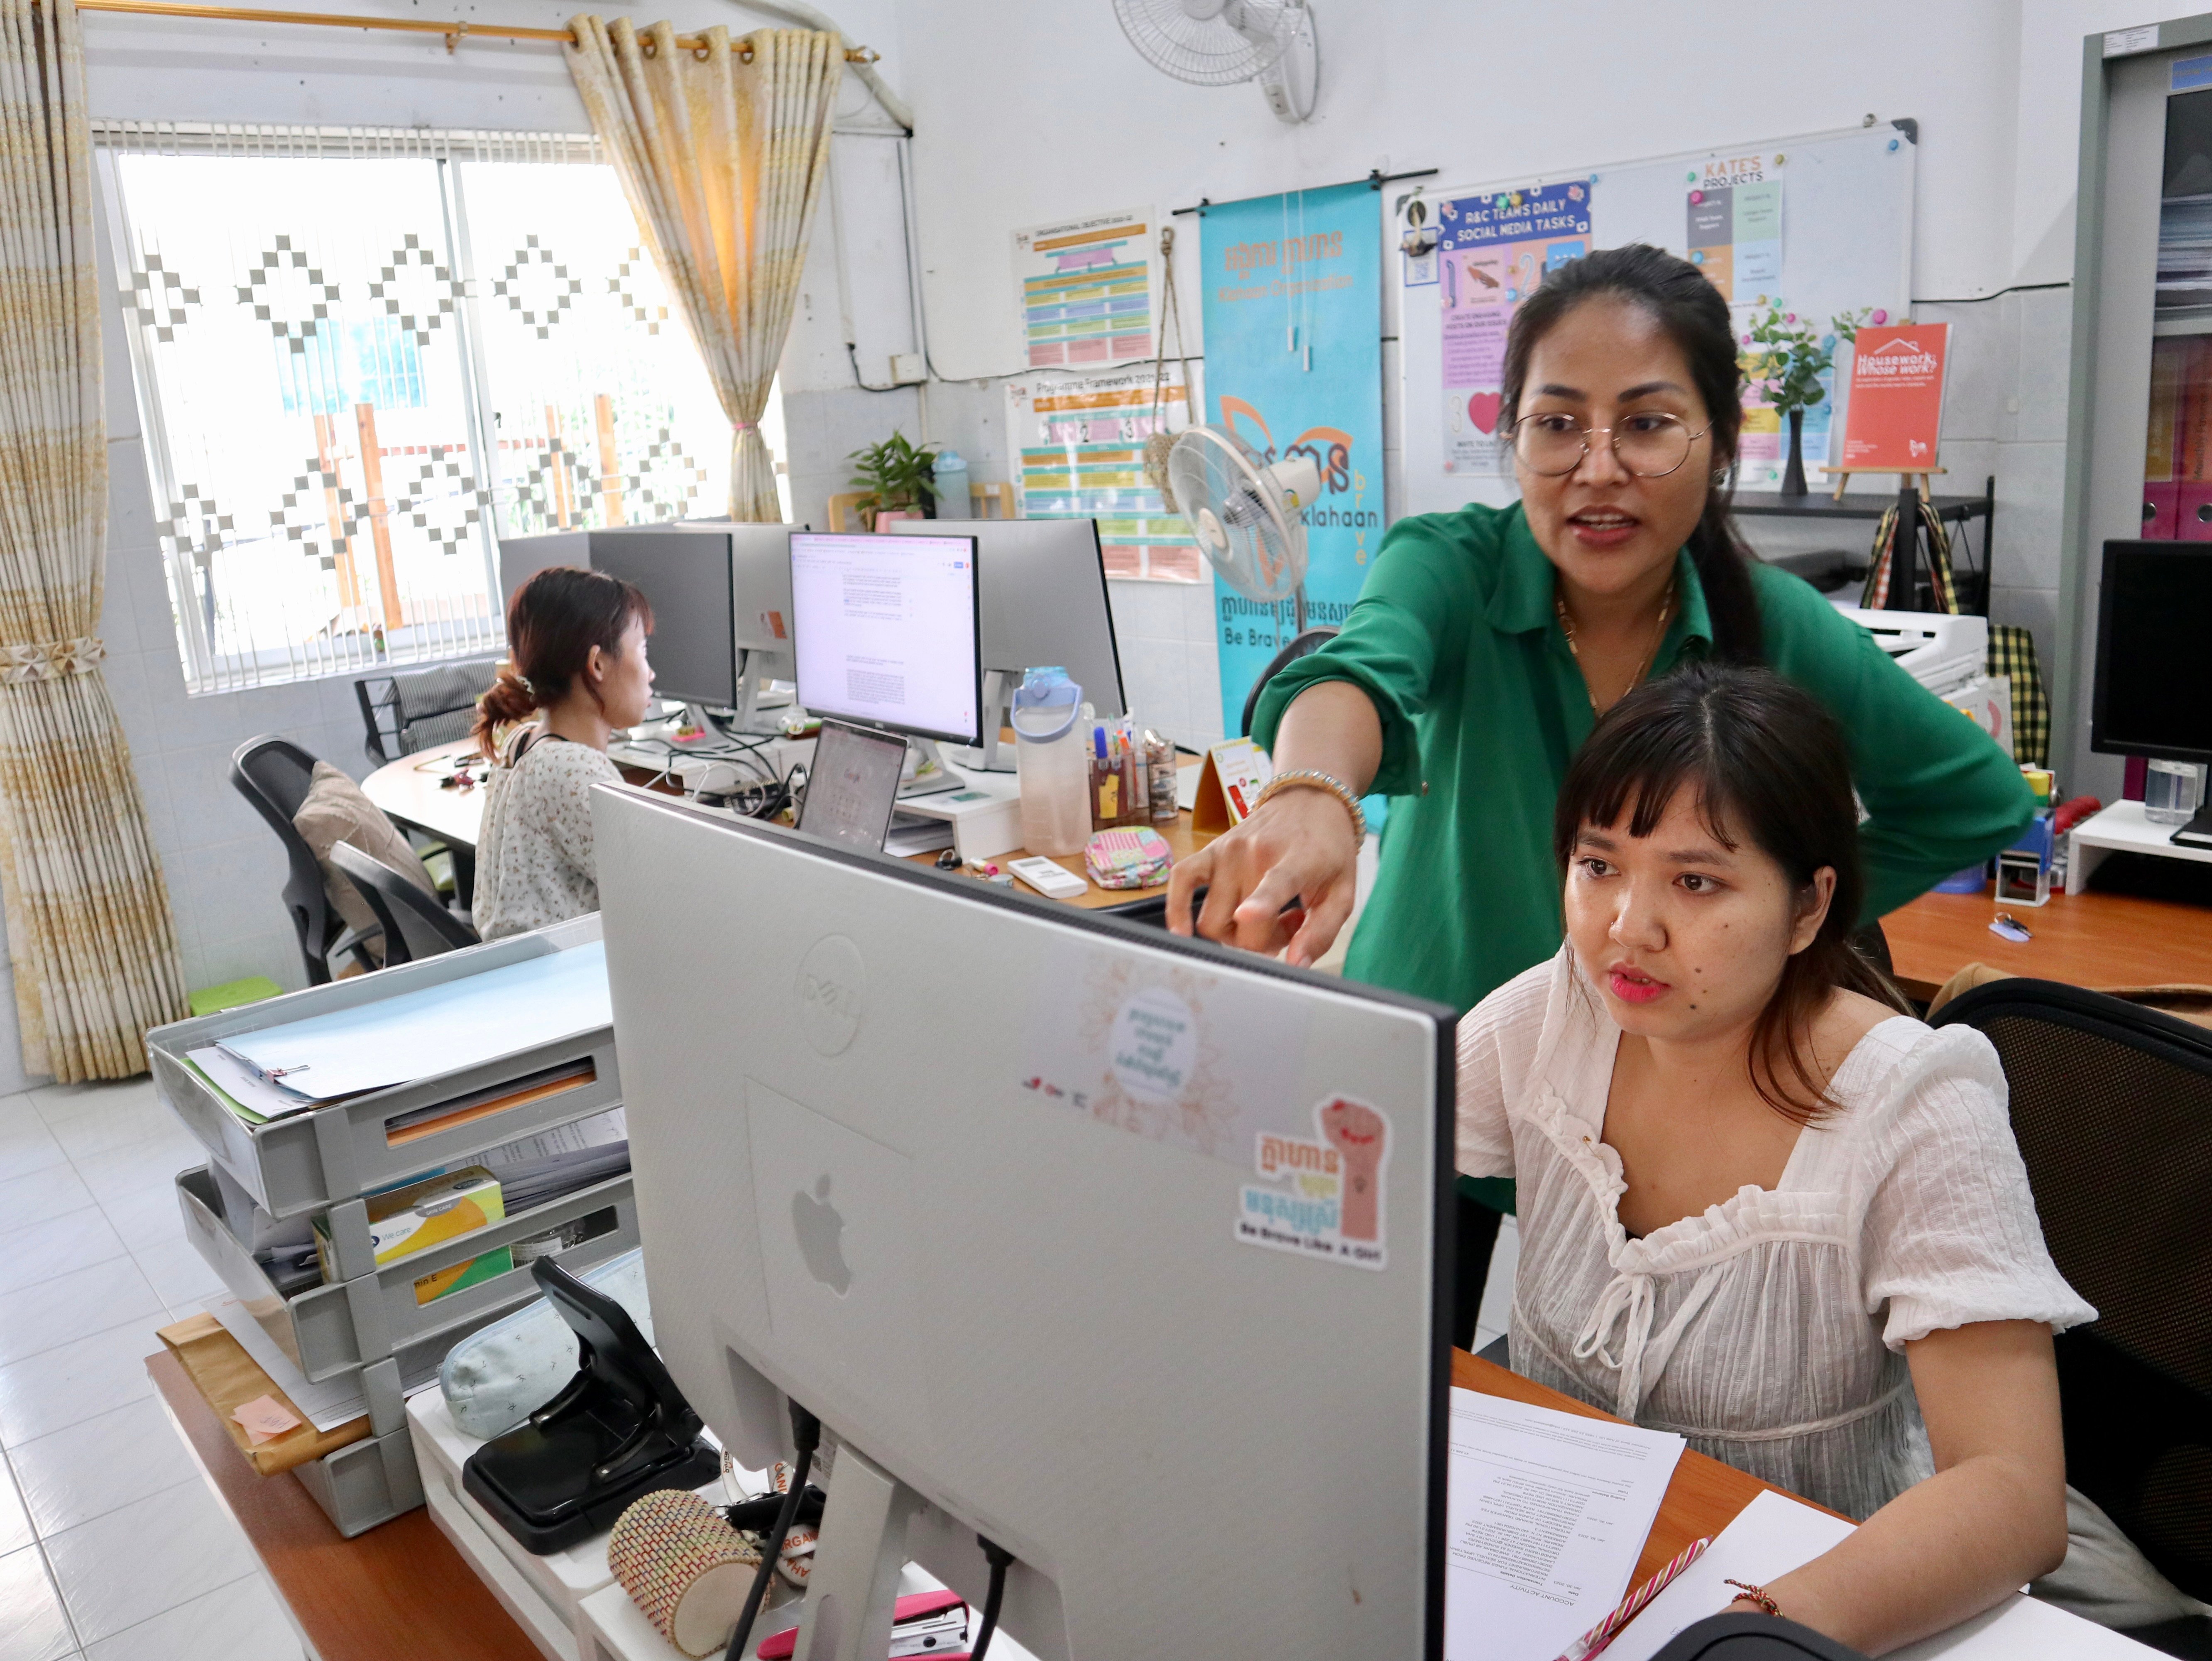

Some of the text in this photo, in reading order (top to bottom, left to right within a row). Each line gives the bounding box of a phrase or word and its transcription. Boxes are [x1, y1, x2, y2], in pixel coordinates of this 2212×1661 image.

[1703, 171, 1763, 188] PROJECTS
[1465, 210, 1490, 225] R&C
[1532, 198, 1567, 214] DAILY
[1457, 214, 1576, 243] SOCIAL MEDIA TASKS
[1036, 377, 1084, 394] Programme
[1085, 375, 1133, 388] Framework
[1225, 627, 1290, 647] Be Brae
[438, 1203, 452, 1213] CARE
[381, 1226, 411, 1241] We care
[1240, 1222, 1382, 1262] Be Brave Like A Girl
[1529, 1502, 1563, 1512] TRANSFERRED
[1489, 1510, 1514, 1519] TRANSFER
[1483, 1523, 1519, 1535] DISBURSEMENT
[1534, 1522, 1571, 1534] INTERNATIONAL
[1538, 1529, 1568, 1539] AMENDMENT
[1482, 1546, 1510, 1556] SWEDBANK
[1524, 1548, 1558, 1560] SUNDBYBERG
[1537, 1547, 1560, 1556] ORIGINAL
[1466, 1556, 1491, 1565] RECEIVED
[1475, 1553, 1497, 1562] SEXUELL
[1507, 1563, 1549, 1576] RIKSFORBUNDET
[1508, 1568, 1546, 1581] INTERNATIONAL
[1515, 1575, 1543, 1585] Transaction
[1509, 1584, 1575, 1607] ACCOUNT ACTIVITY
